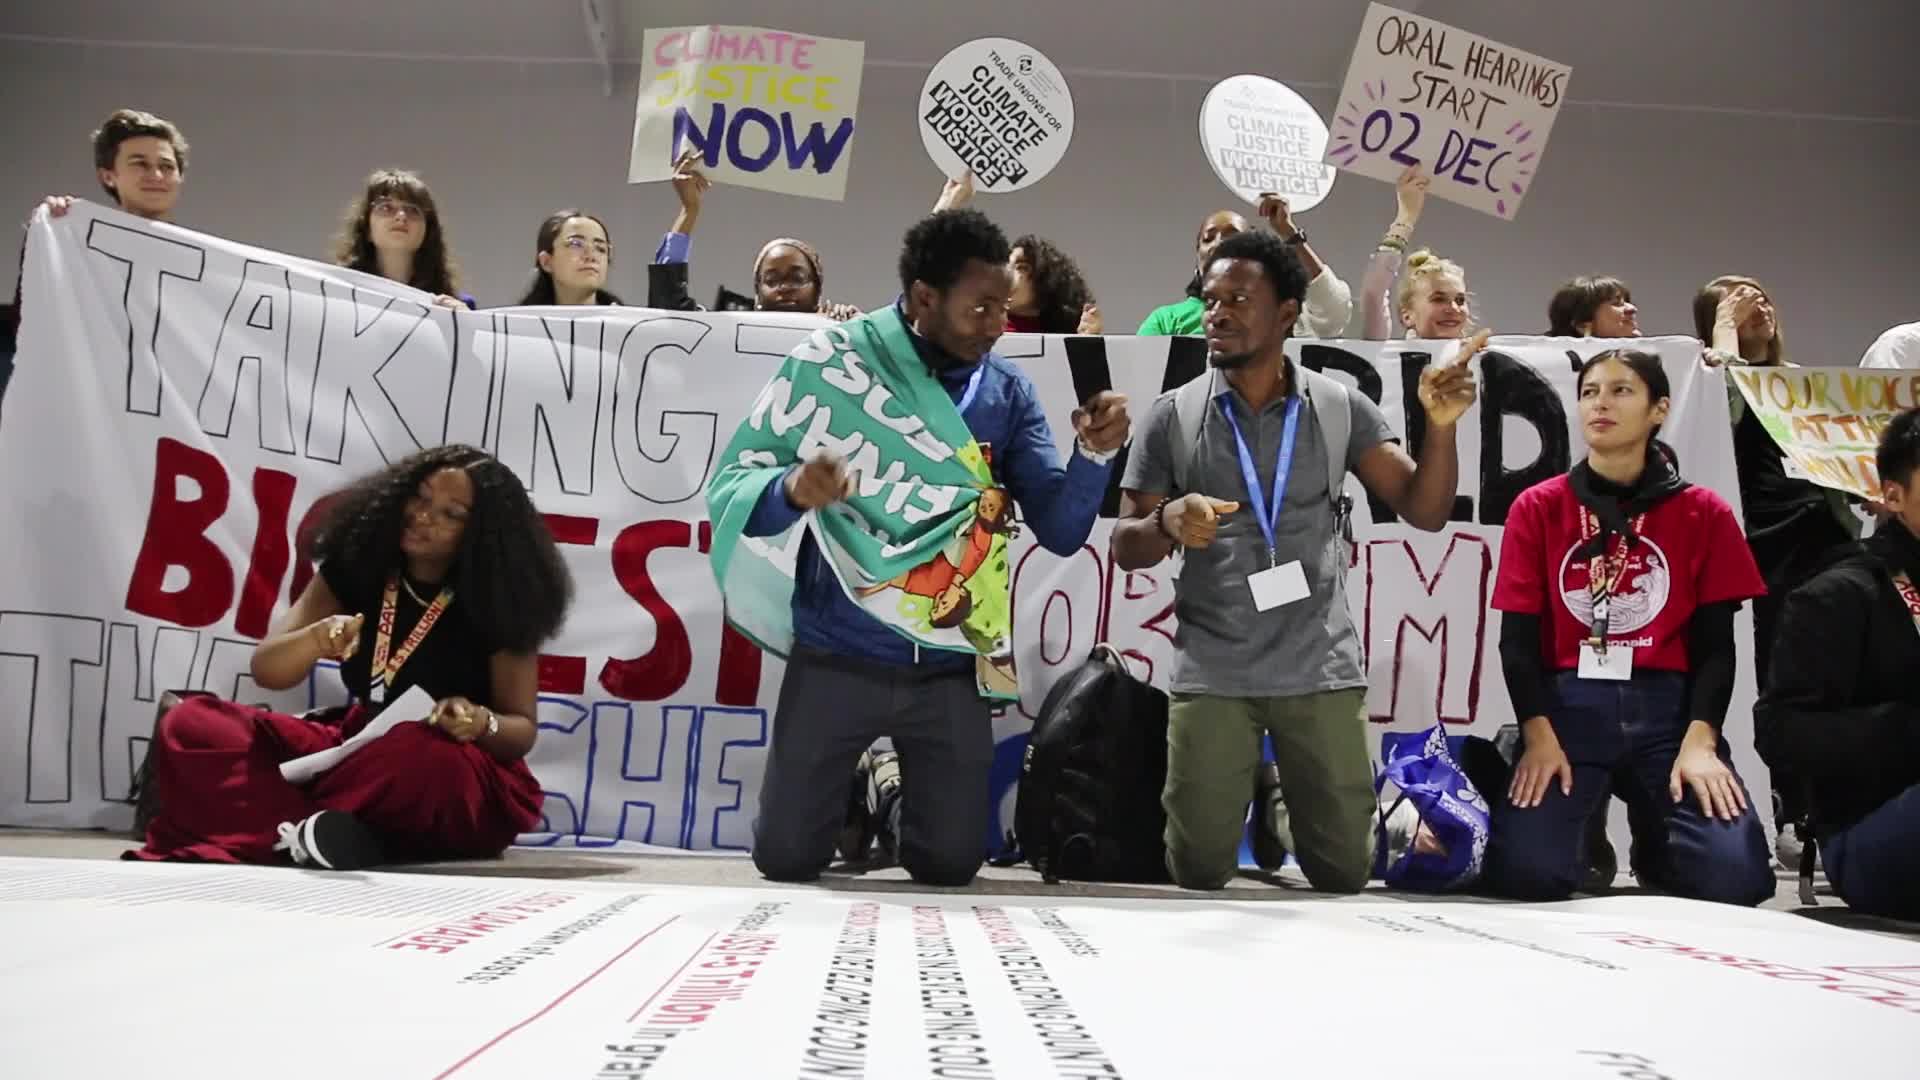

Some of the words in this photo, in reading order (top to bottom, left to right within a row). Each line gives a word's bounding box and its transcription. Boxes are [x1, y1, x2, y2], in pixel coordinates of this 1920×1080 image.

[988, 49, 1017, 81] TRADE
[1013, 79, 1047, 115] UNIONS
[1044, 112, 1063, 133] FOR
[1376, 16, 1454, 70] ORAL
[1464, 41, 1566, 108] HEARINGS
[960, 82, 1031, 156] JUSTICE
[972, 65, 1049, 147] CLIMATE
[1227, 113, 1311, 142] CLIMATE
[1398, 70, 1506, 130] START
[671, 102, 854, 174] NOW
[927, 109, 1001, 187] JUSTICE
[1234, 132, 1312, 159] JUSTICE
[1361, 109, 1421, 167] 02
[1433, 129, 1512, 193] DEC
[1238, 170, 1319, 195] JUSTICE
[87, 217, 718, 504] TAKING
[1735, 371, 1845, 414] YOUR
[647, 970, 755, 1024] Trillion
[814, 955, 876, 1026] DEVELOPING
[919, 970, 984, 1041] DEVELOPING
[998, 954, 1078, 1019] DEVELOPING
